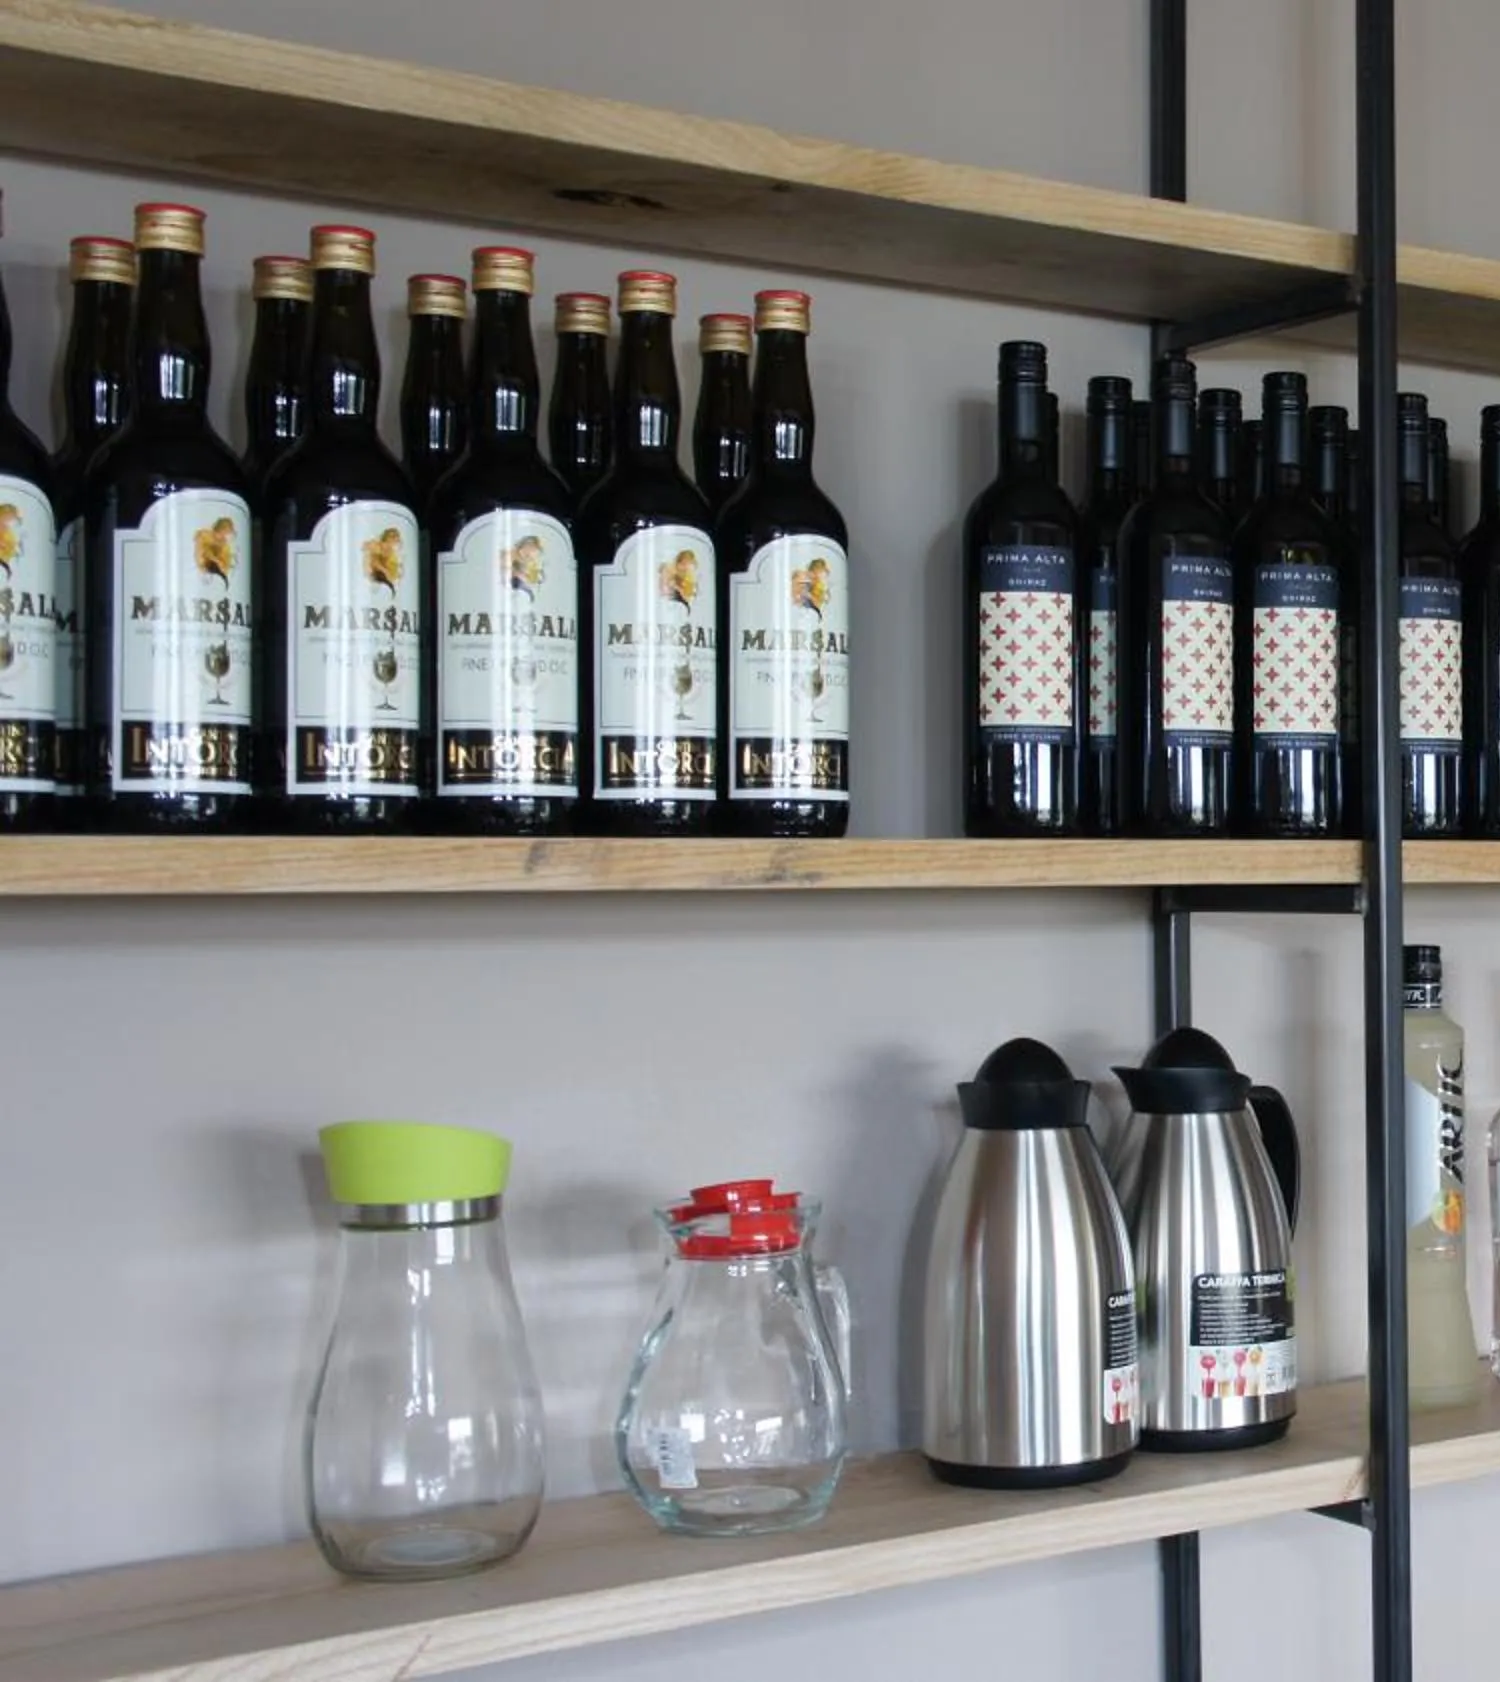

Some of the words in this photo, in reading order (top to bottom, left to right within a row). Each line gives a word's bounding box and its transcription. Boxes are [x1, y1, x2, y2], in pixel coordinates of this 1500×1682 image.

[987, 554, 1029, 564] PRIMA
[1035, 554, 1066, 565] ALTA
[1171, 564, 1210, 574] PRIMA
[1261, 572, 1301, 582] PRIMA
[130, 595, 253, 631] MARSAL
[304, 603, 419, 636] MARSAL
[607, 622, 717, 650] MARSAL
[741, 628, 849, 656] MARSAL
[1436, 1047, 1463, 1185] ARTIC
